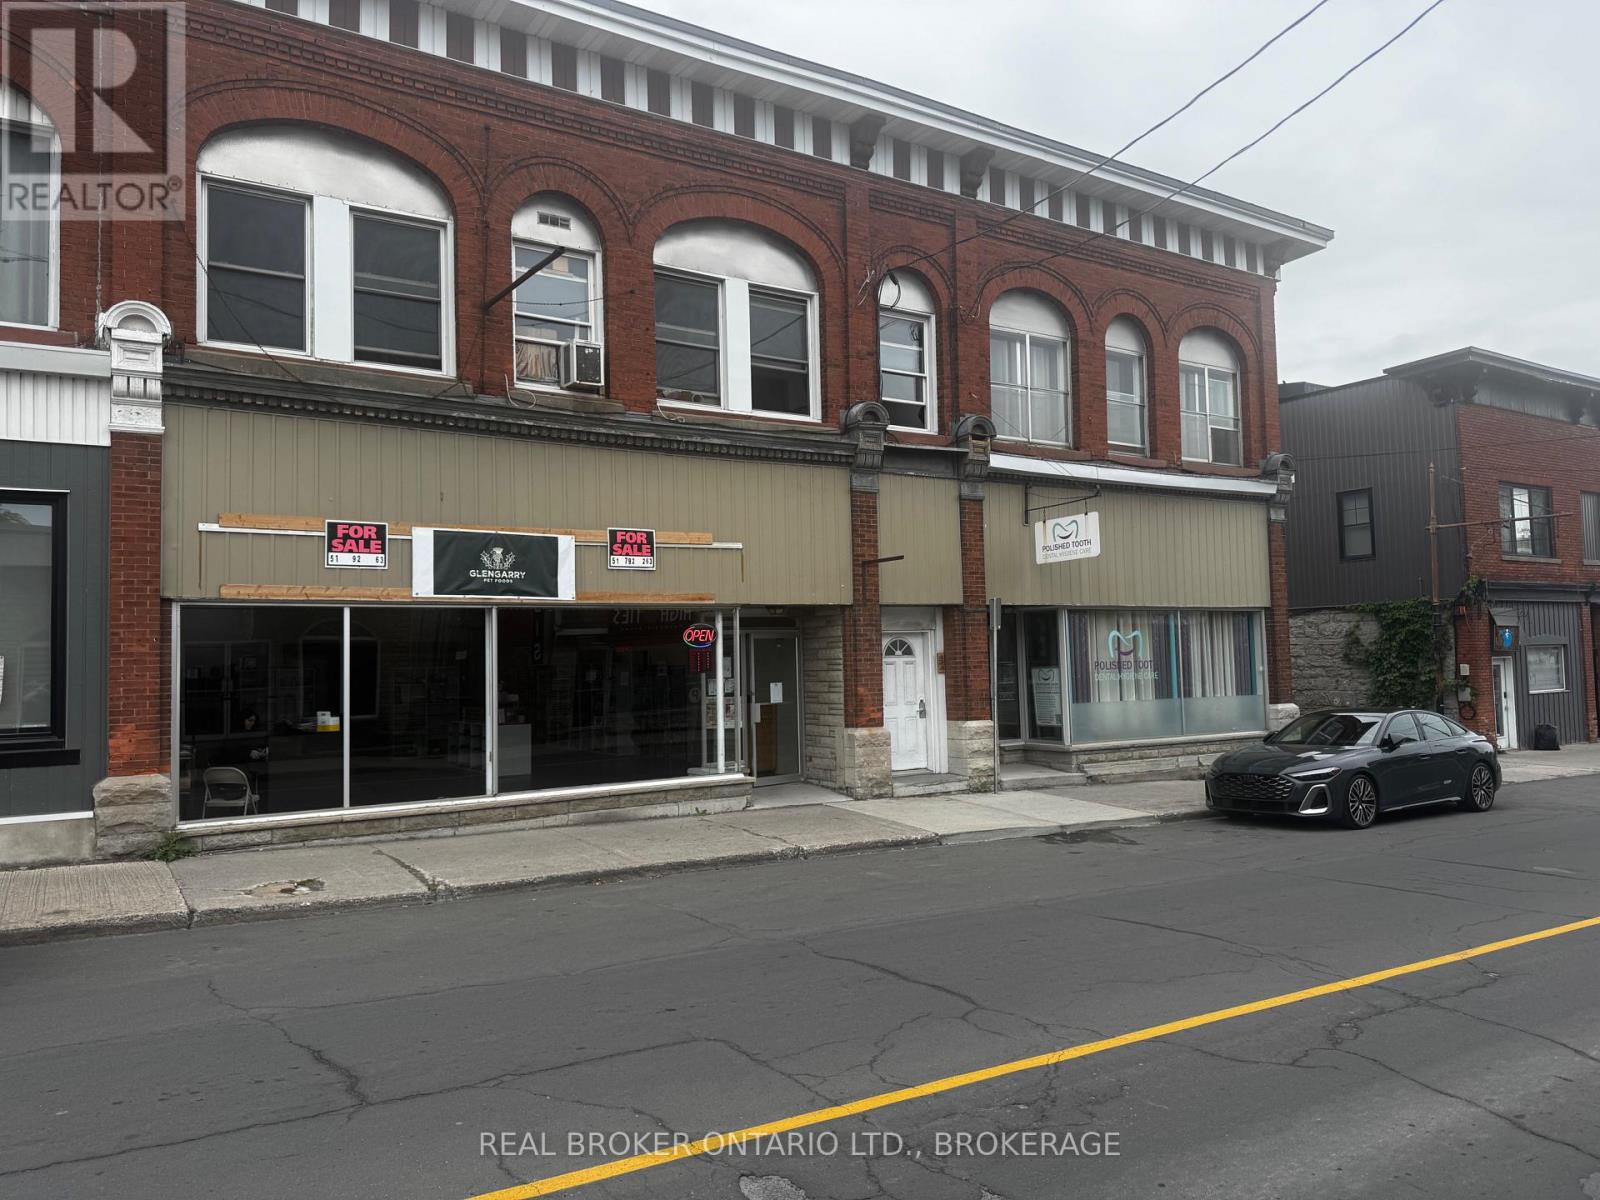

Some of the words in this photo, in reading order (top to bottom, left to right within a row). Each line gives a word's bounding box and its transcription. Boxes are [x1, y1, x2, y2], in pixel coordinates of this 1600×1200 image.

[337, 524, 377, 539] FOR
[616, 531, 647, 544] FOR
[331, 538, 382, 553] SALE
[612, 543, 651, 556] SALE
[1042, 541, 1070, 552] POLISHED
[1072, 538, 1092, 548] TOOTH
[469, 569, 527, 579] GLENGARRY
[685, 629, 715, 642] OPEN
[1134, 660, 1155, 670] TOOT
